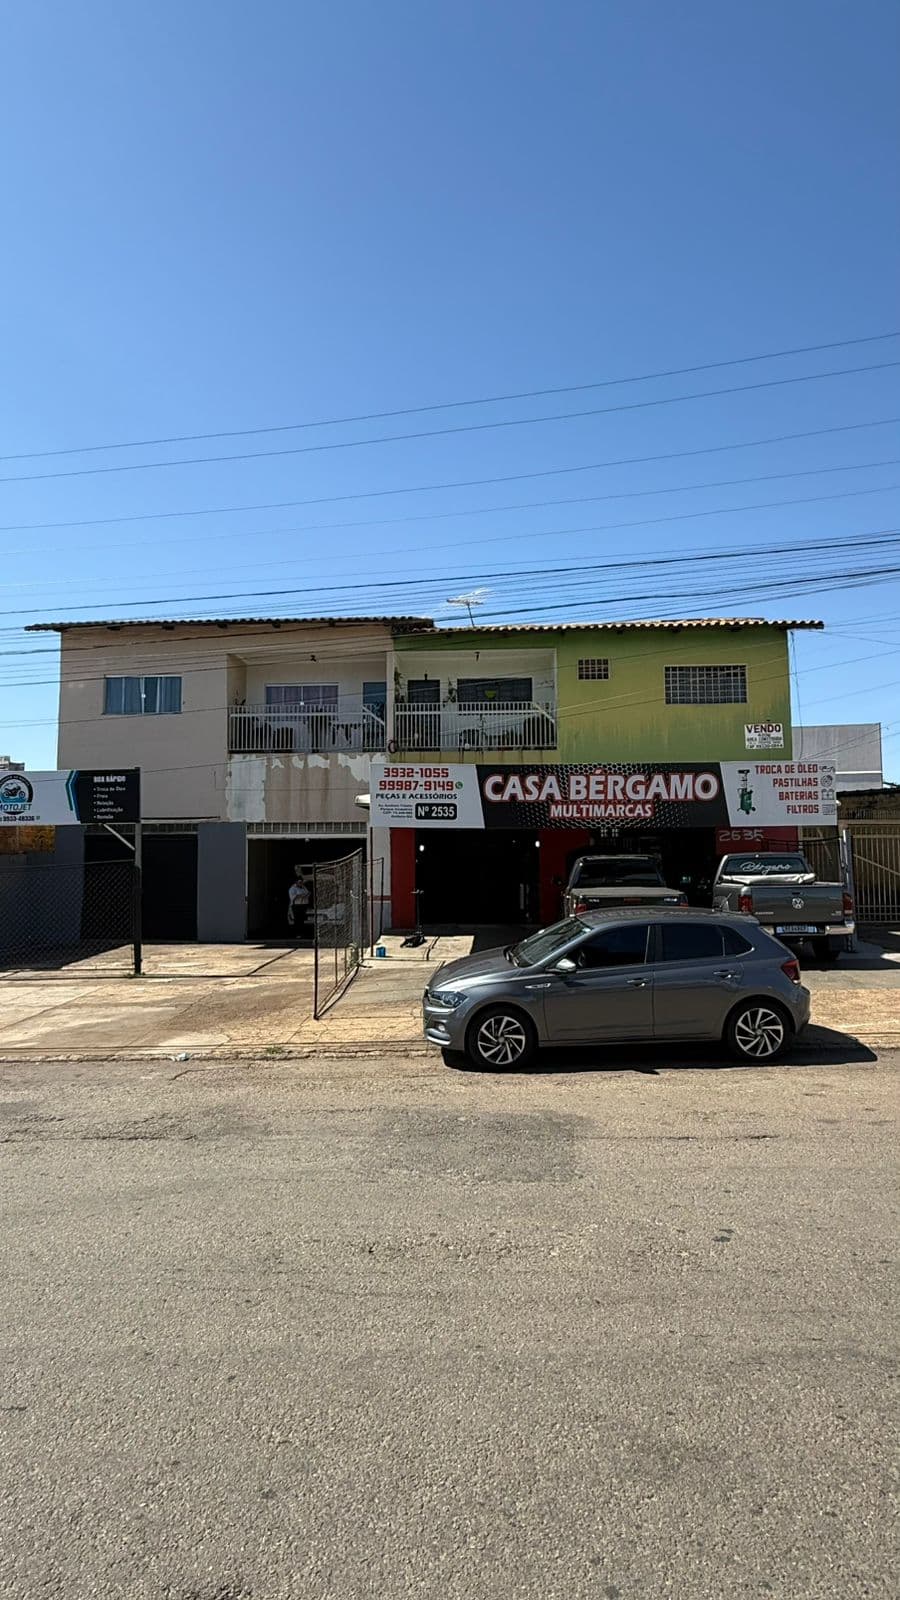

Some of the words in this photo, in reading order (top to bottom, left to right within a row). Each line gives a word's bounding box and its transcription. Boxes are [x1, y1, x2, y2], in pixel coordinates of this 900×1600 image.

[746, 724, 781, 733] VENDO
[384, 767, 449, 778] 3932-1055
[755, 764, 782, 774] TROCA
[785, 764, 795, 773] DE
[379, 781, 454, 791] 99987-9149
[484, 775, 563, 801] CASA
[570, 769, 718, 800] BÉRGAMO
[773, 778, 818, 787] PASTILHAS
[409, 792, 458, 800] ACESSÓRIOS
[779, 791, 819, 800] BATERIAS
[431, 806, 455, 817] 2535
[550, 804, 652, 817] MULTIMARCAS
[787, 804, 819, 814] FILTROS
